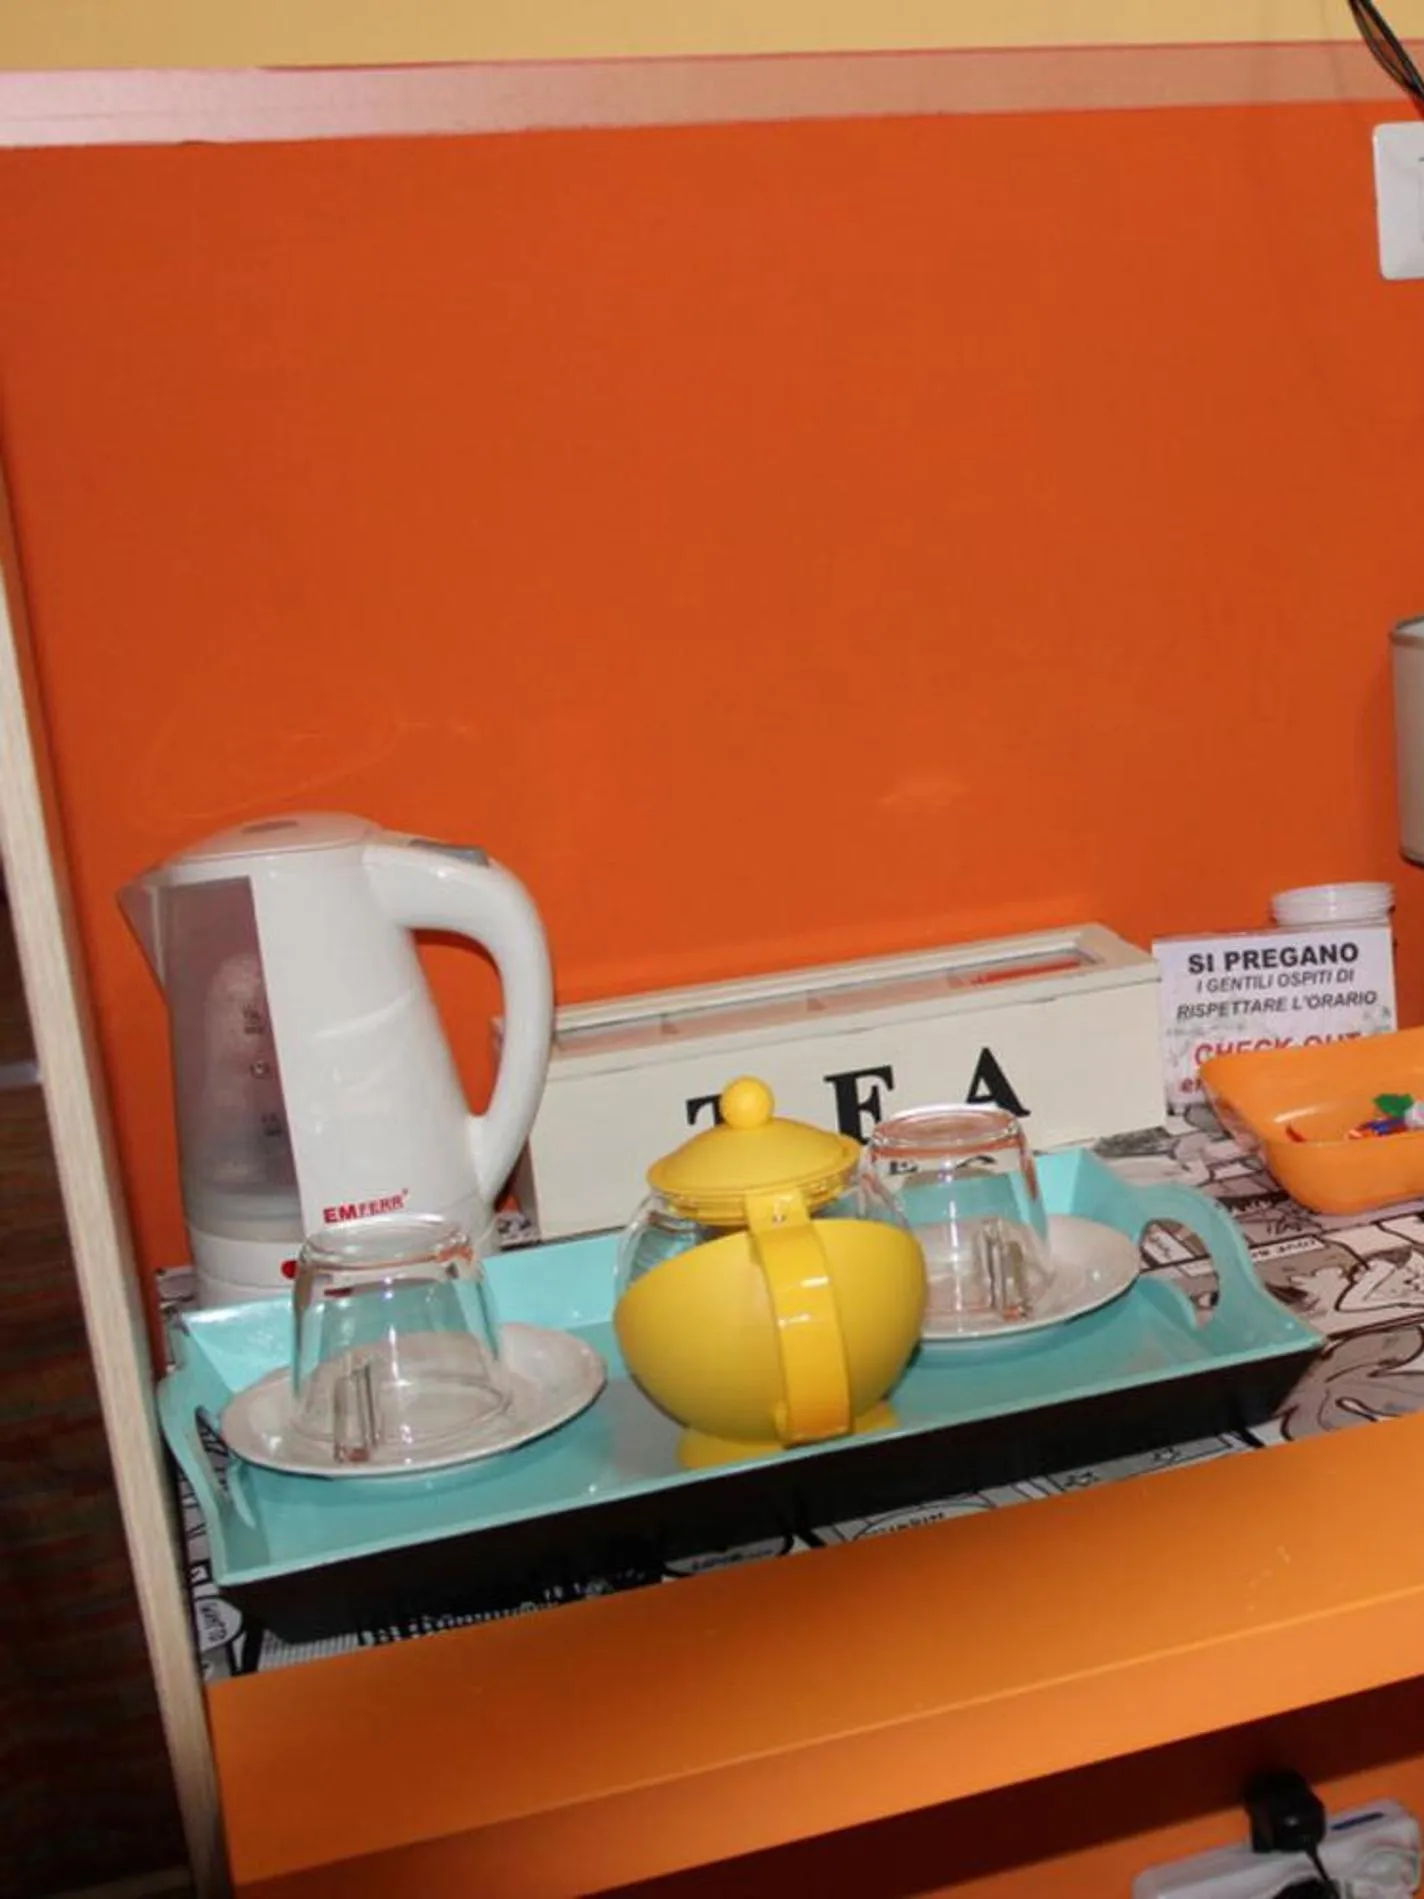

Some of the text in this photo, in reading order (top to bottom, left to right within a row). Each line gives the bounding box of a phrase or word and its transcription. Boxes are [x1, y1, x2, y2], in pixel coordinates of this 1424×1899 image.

[1188, 942, 1359, 974] SI PREGANO
[1207, 974, 1274, 993] GENTILI
[1277, 970, 1333, 988] OSPITI
[1336, 968, 1355, 983] DI
[1176, 991, 1378, 1020] RISPETTARE L'ORARIO
